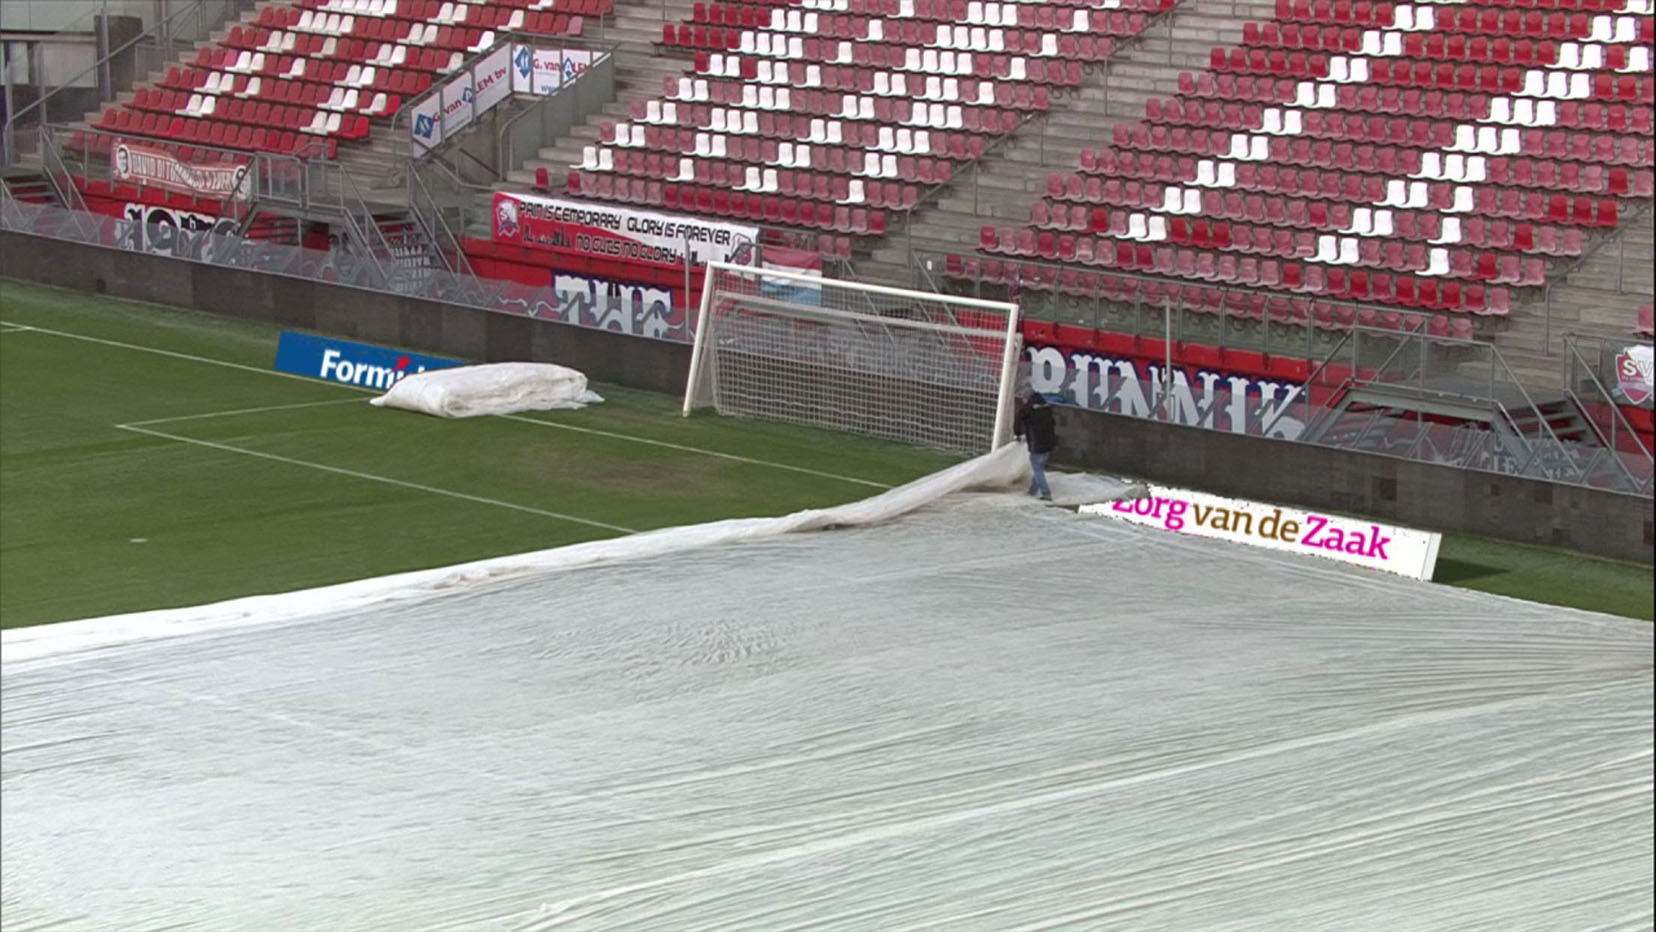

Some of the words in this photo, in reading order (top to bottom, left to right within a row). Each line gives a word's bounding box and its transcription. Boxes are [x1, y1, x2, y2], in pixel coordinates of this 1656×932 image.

[545, 62, 562, 73] van
[443, 99, 462, 115] van
[494, 66, 507, 79] bv
[132, 153, 156, 176] DAVID
[156, 158, 165, 178] DI
[519, 201, 543, 218] PAIN
[544, 204, 554, 220] IS
[555, 206, 622, 230] TEMPORARY
[627, 216, 664, 237] GLORY
[664, 221, 675, 238] IS
[675, 223, 731, 246] FOREVER
[639, 244, 677, 264] GLORY
[1192, 503, 1252, 535] van
[1257, 510, 1299, 543] de
[1301, 515, 1391, 560] Zaak
